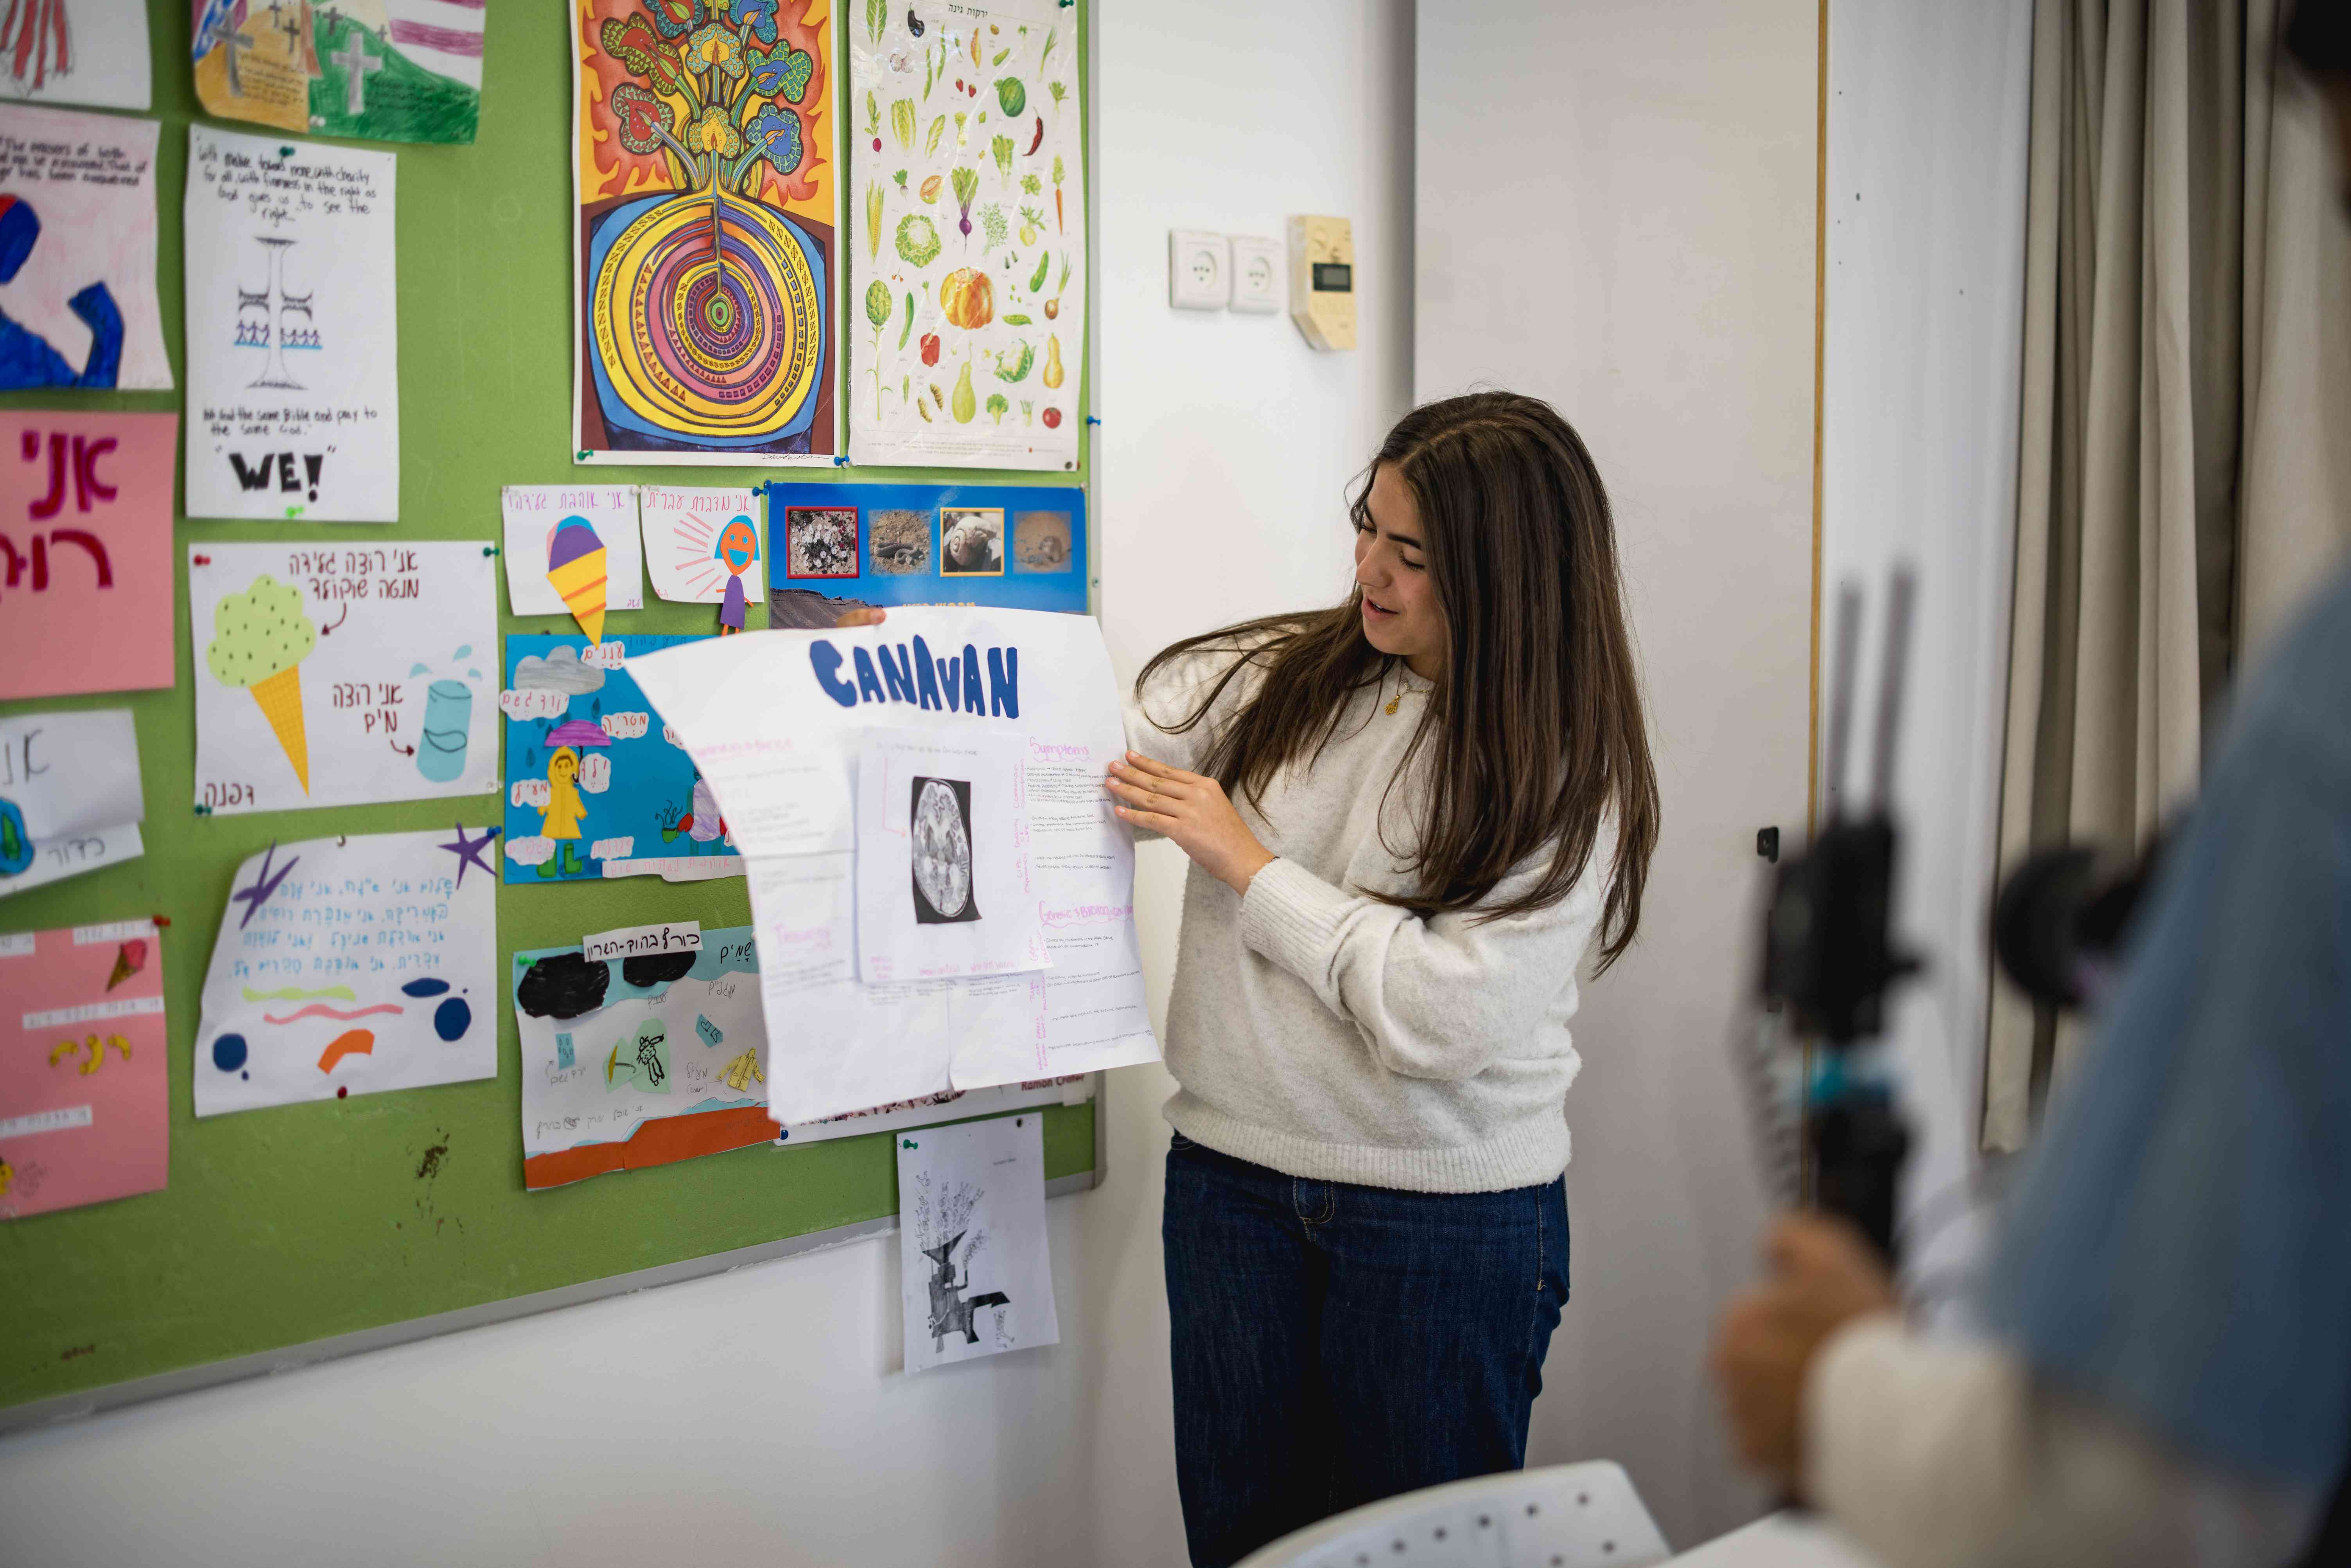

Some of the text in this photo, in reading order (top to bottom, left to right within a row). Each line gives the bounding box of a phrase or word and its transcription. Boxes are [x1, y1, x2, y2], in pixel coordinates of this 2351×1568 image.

[949, 4, 987, 19] ירקות גינה
[336, 168, 370, 184] charity
[304, 181, 312, 191] in
[318, 181, 335, 195] the
[340, 187, 360, 201] right
[366, 189, 376, 198] as
[279, 196, 289, 205] us
[300, 198, 314, 209] to
[324, 203, 341, 213] see
[350, 201, 370, 214] the
[237, 407, 253, 420] the
[257, 409, 280, 422] same
[284, 408, 309, 421] Bible
[315, 409, 332, 421] and
[364, 405, 377, 419] to
[211, 424, 231, 436] the
[241, 425, 270, 435] same
[22, 430, 118, 521] אני
[559, 491, 598, 509] אוהבת
[608, 492, 625, 510] אני
[647, 492, 750, 512] אני מדברת עברית
[289, 550, 418, 575] אני רוצה גלידה
[309, 579, 419, 600] מנטה שוקולד
[809, 634, 1019, 719] CANAVAN
[333, 684, 403, 708] אני רוצה
[364, 709, 397, 734] מים
[1030, 736, 1089, 758] Symptoms
[204, 783, 255, 807] דפנה
[1021, 1079, 1053, 1091] Ramon
